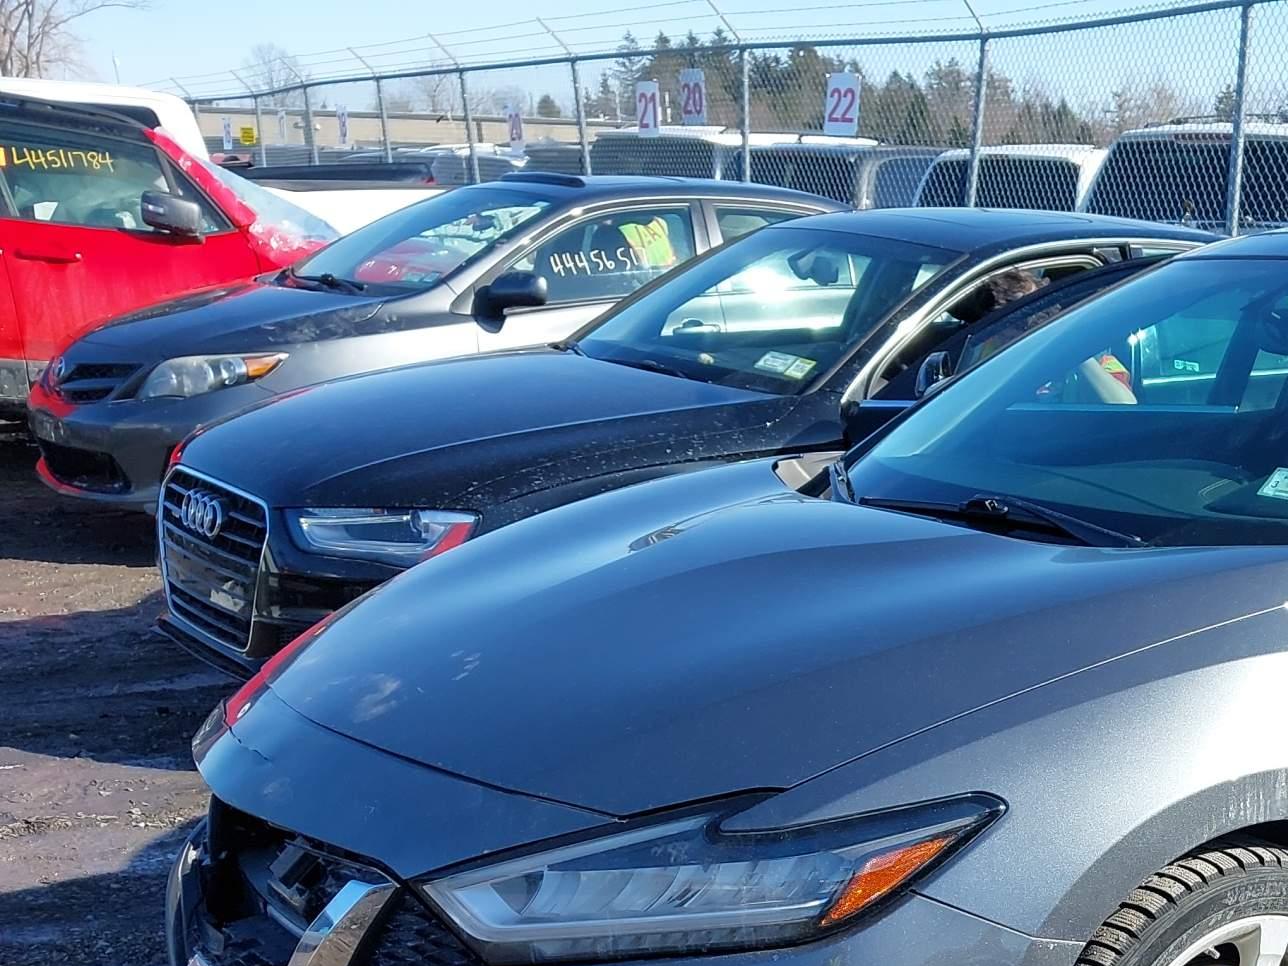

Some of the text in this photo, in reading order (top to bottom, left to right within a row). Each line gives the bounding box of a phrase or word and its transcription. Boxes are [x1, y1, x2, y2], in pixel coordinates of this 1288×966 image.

[638, 92, 658, 129] 21
[682, 82, 704, 116] 20
[827, 87, 855, 123] 22
[11, 146, 114, 173] 44511784
